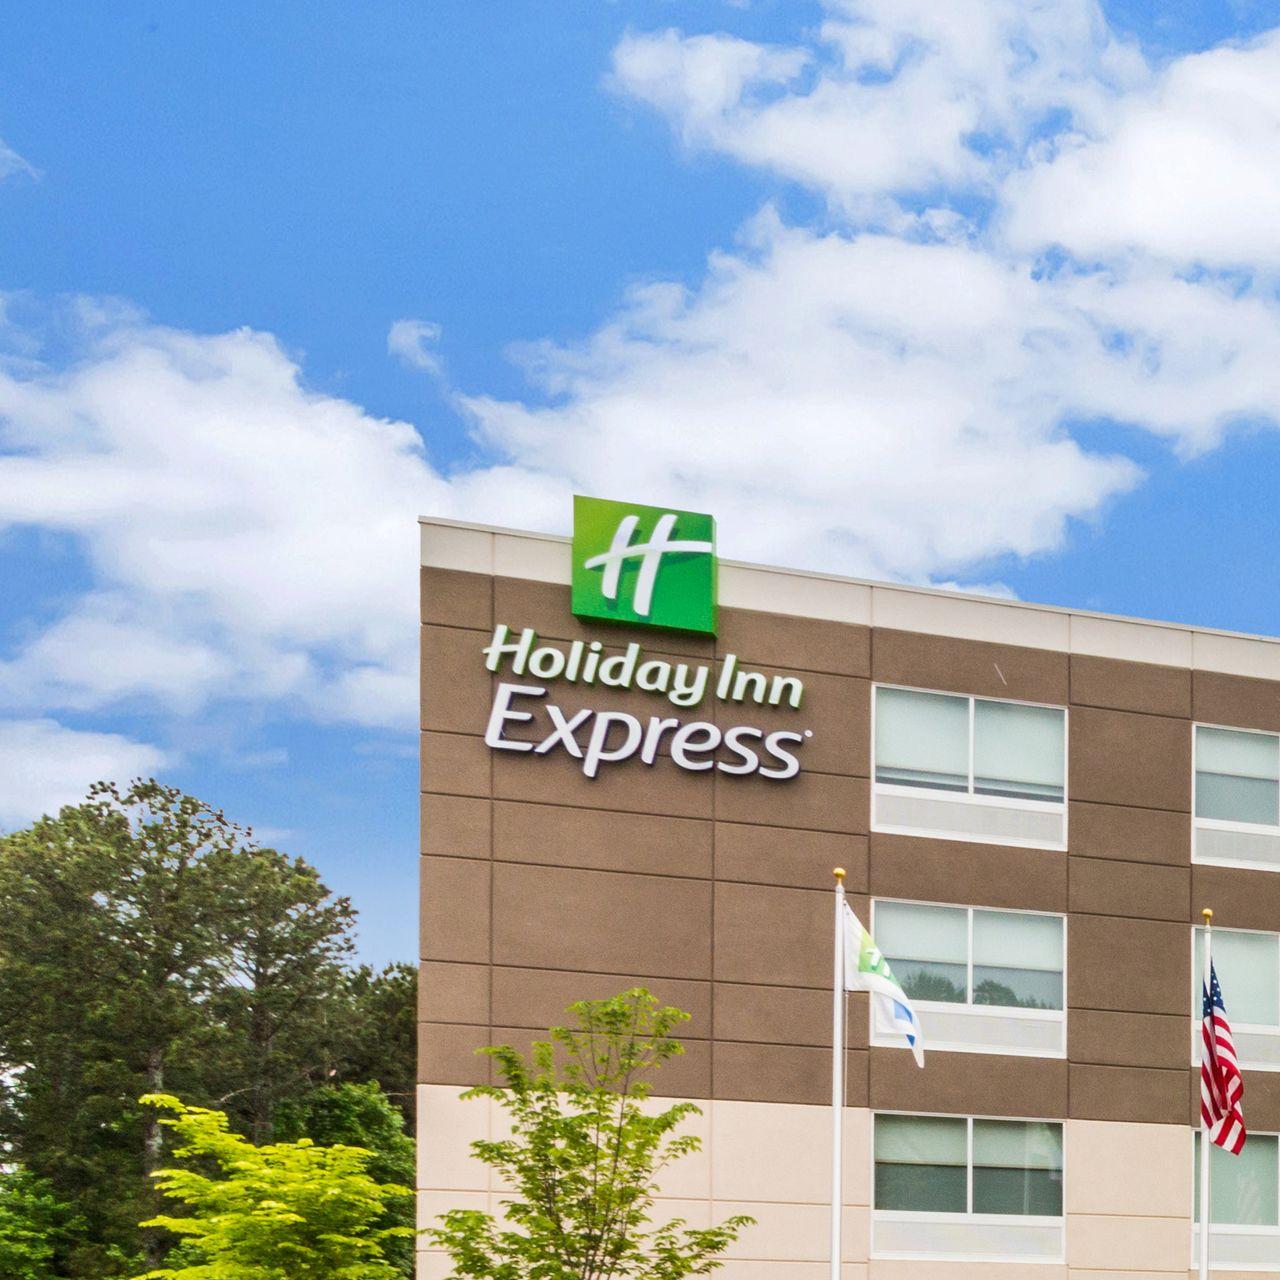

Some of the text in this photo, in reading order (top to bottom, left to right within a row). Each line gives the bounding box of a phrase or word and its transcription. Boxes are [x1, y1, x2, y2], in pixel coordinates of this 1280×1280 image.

[483, 624, 804, 709] Holiday Inn
[484, 682, 803, 779] Express
